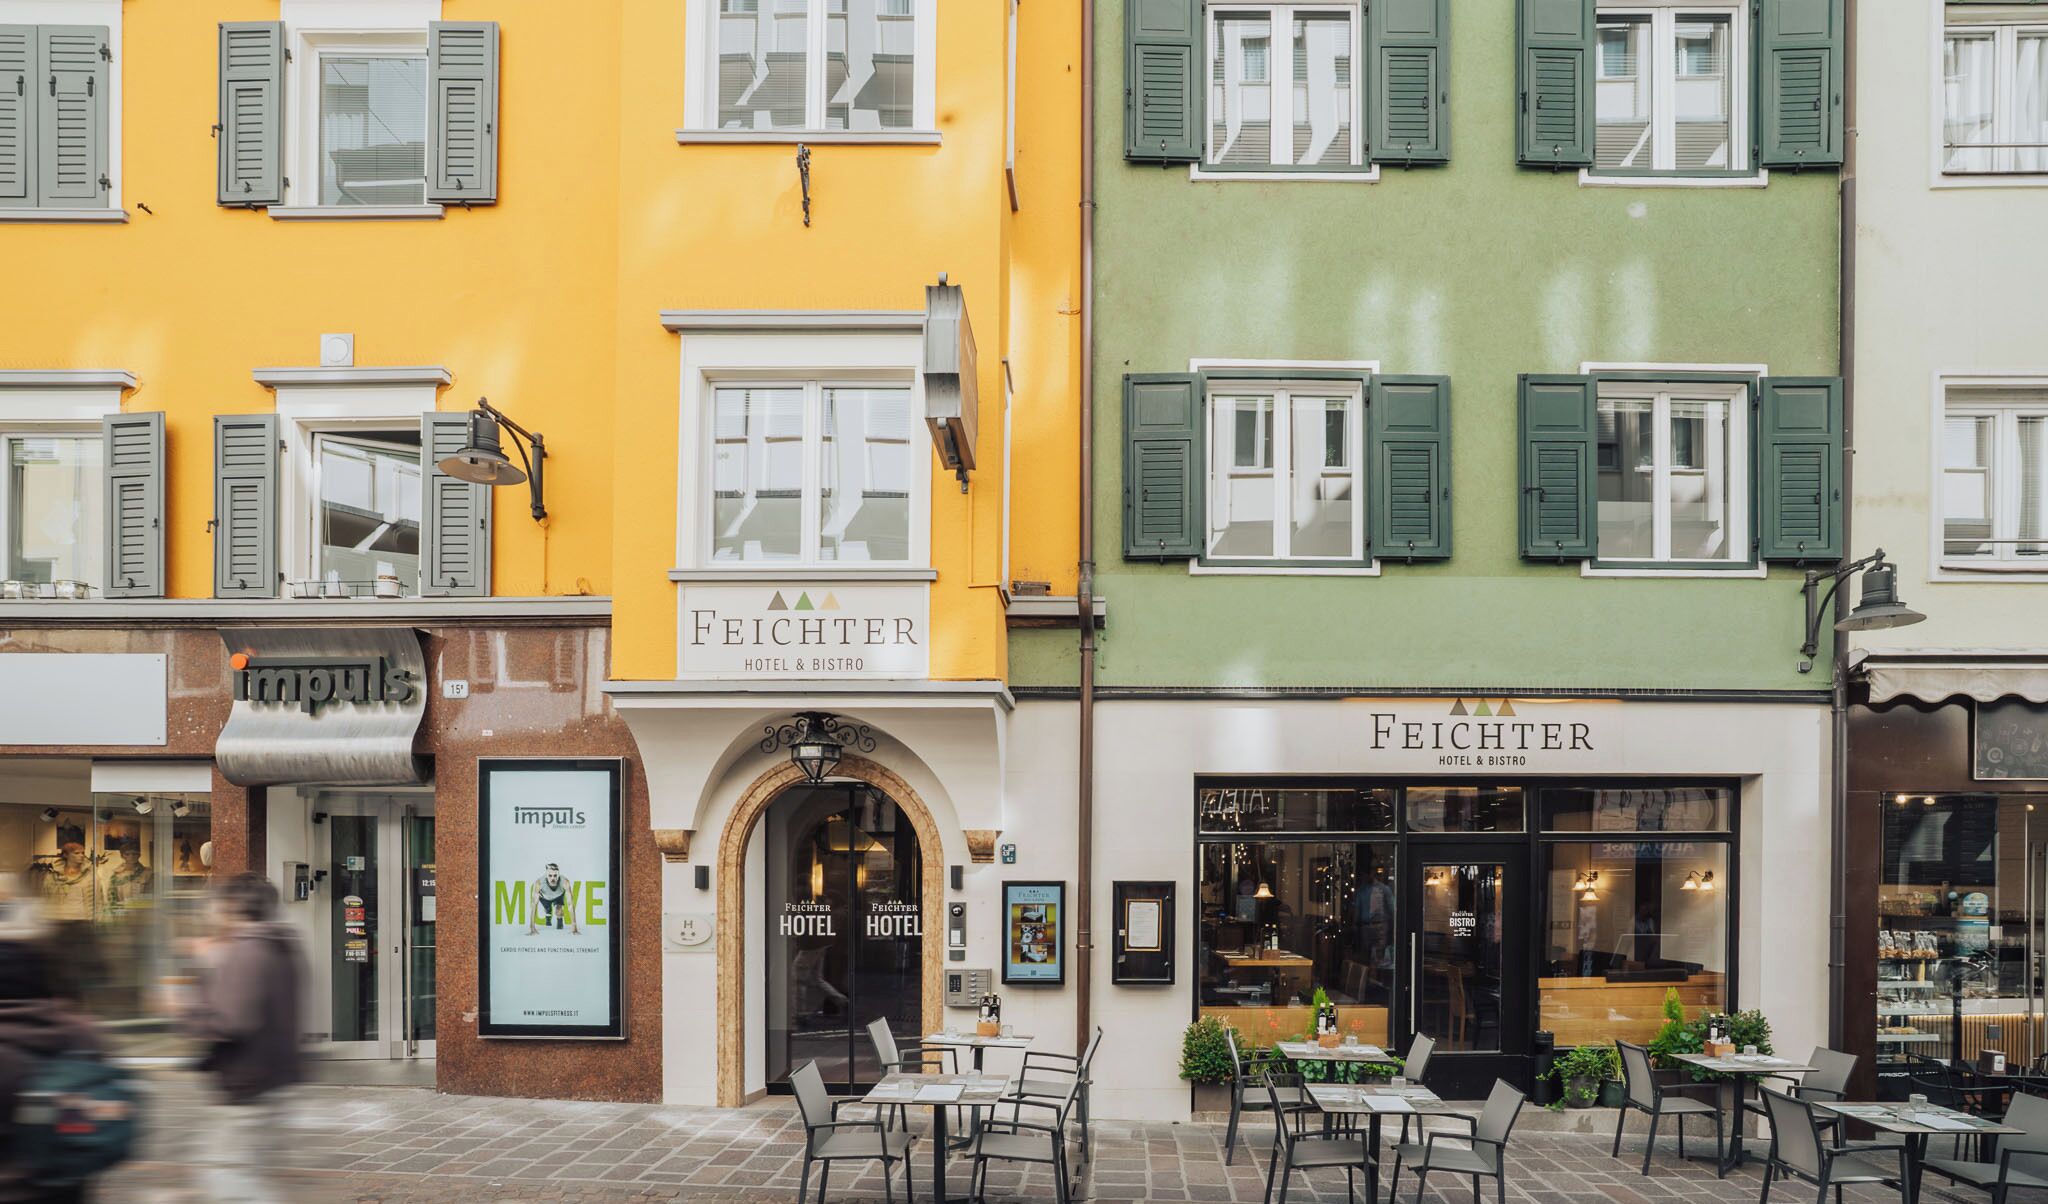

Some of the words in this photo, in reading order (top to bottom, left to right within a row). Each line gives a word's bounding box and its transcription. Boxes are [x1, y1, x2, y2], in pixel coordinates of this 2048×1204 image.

[691, 610, 918, 646] FEICHTER
[745, 658, 788, 671] HOTEL
[796, 658, 805, 671] &
[813, 658, 864, 671] BISTRO
[230, 653, 412, 715] impuls
[1370, 713, 1594, 750] FEICHTER
[1439, 756, 1472, 766] HOTEL
[1476, 756, 1483, 766] &
[1488, 756, 1526, 766] BISTRO
[514, 806, 586, 828] impuls
[785, 903, 831, 911] FEICHTER
[872, 903, 918, 912] FEICHTER
[780, 915, 836, 936] HOTEL
[867, 915, 923, 936] HOTEL
[1449, 917, 1476, 927] BISTRO
